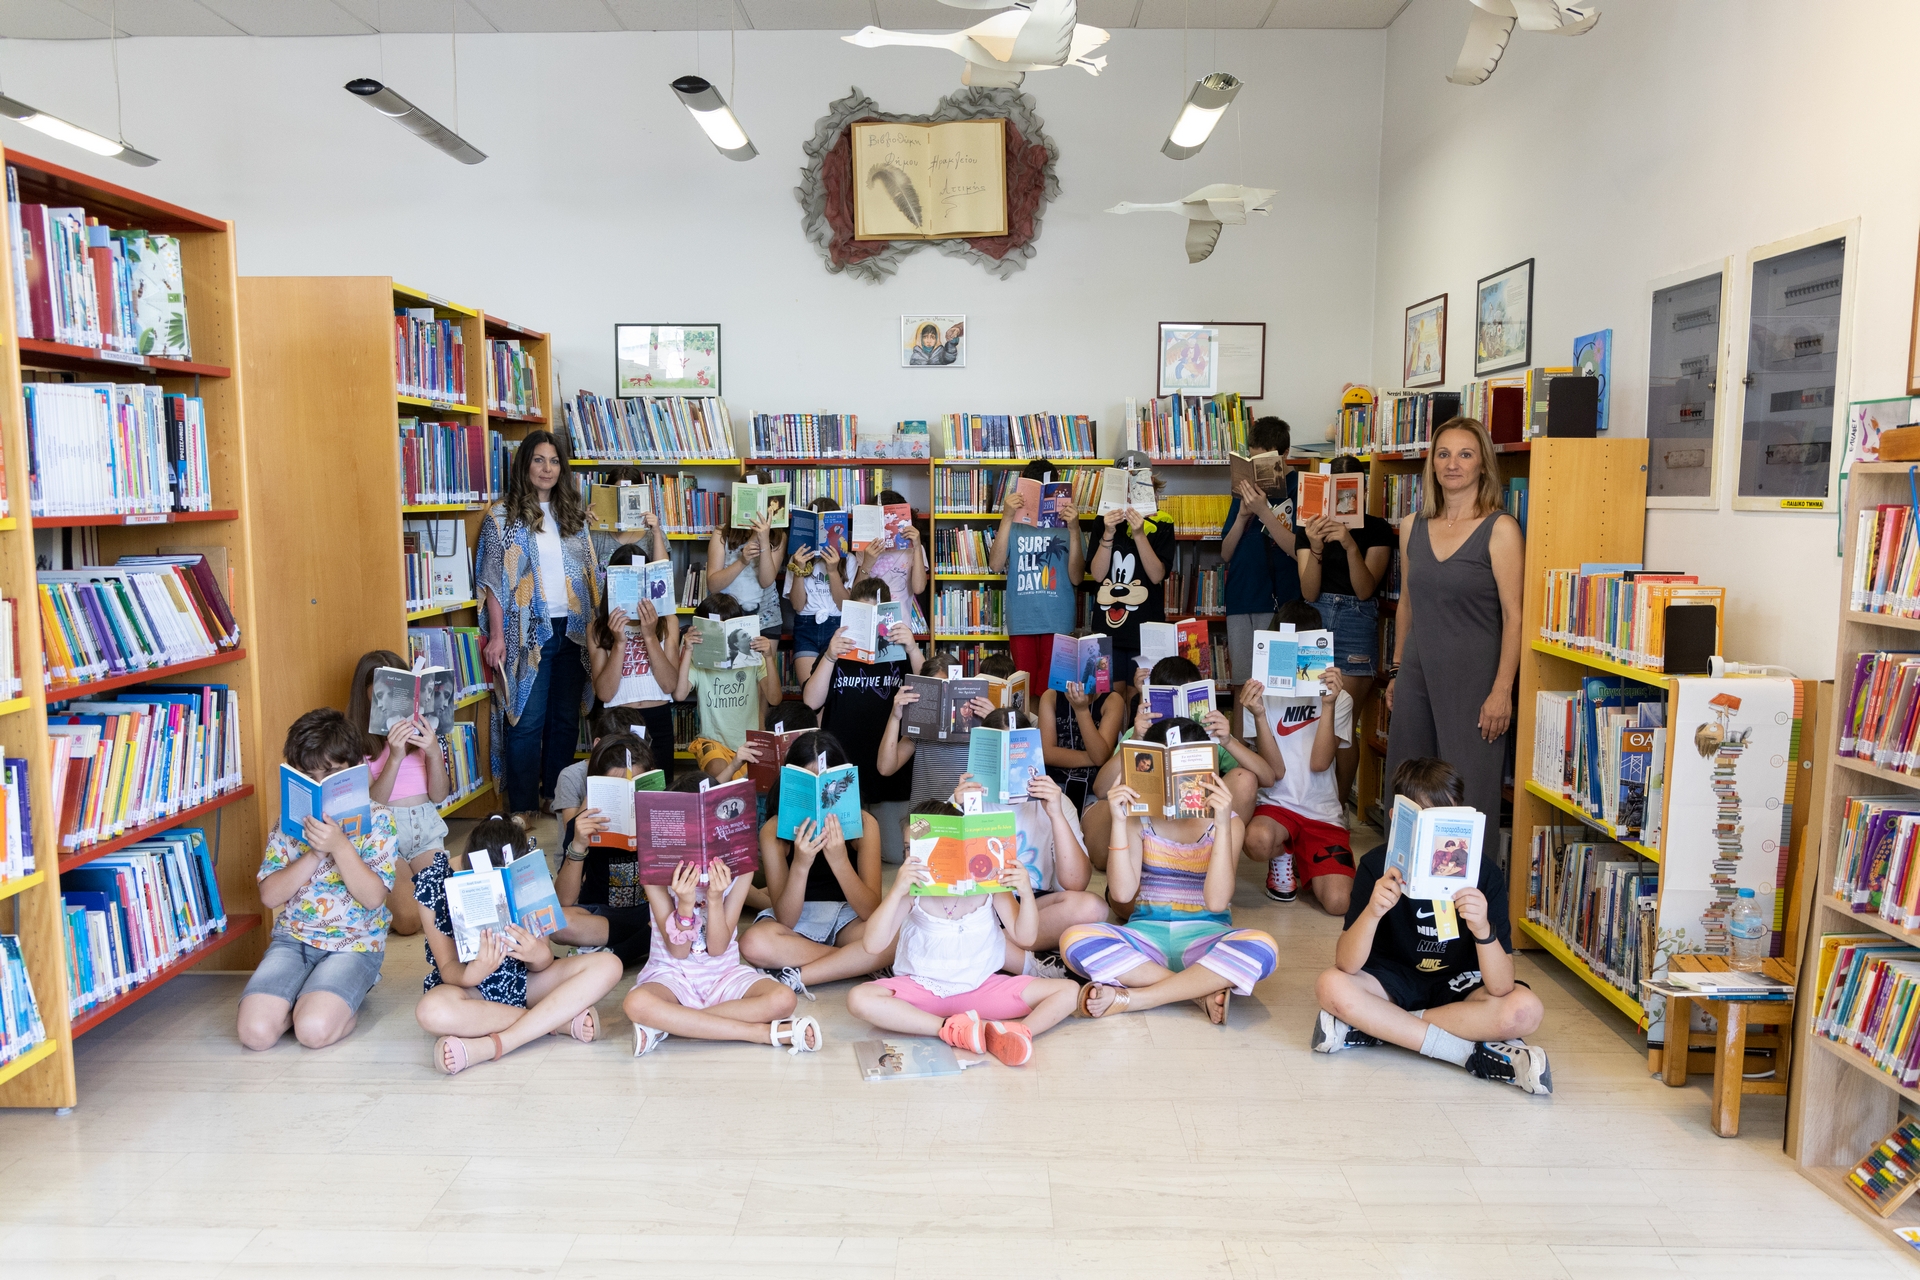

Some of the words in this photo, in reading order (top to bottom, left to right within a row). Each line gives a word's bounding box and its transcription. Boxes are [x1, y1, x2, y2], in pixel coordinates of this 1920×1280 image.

[1018, 536, 1051, 553] SURF
[1018, 554, 1039, 572] ALL
[1017, 572, 1041, 591] DAY
[713, 677, 745, 695] fresh
[706, 693, 749, 708] Summer
[1283, 706, 1317, 722] NIKE
[1630, 734, 1654, 746] ΘΑ
[1417, 940, 1448, 953] NIKE
[1420, 958, 1442, 968] NIKE
